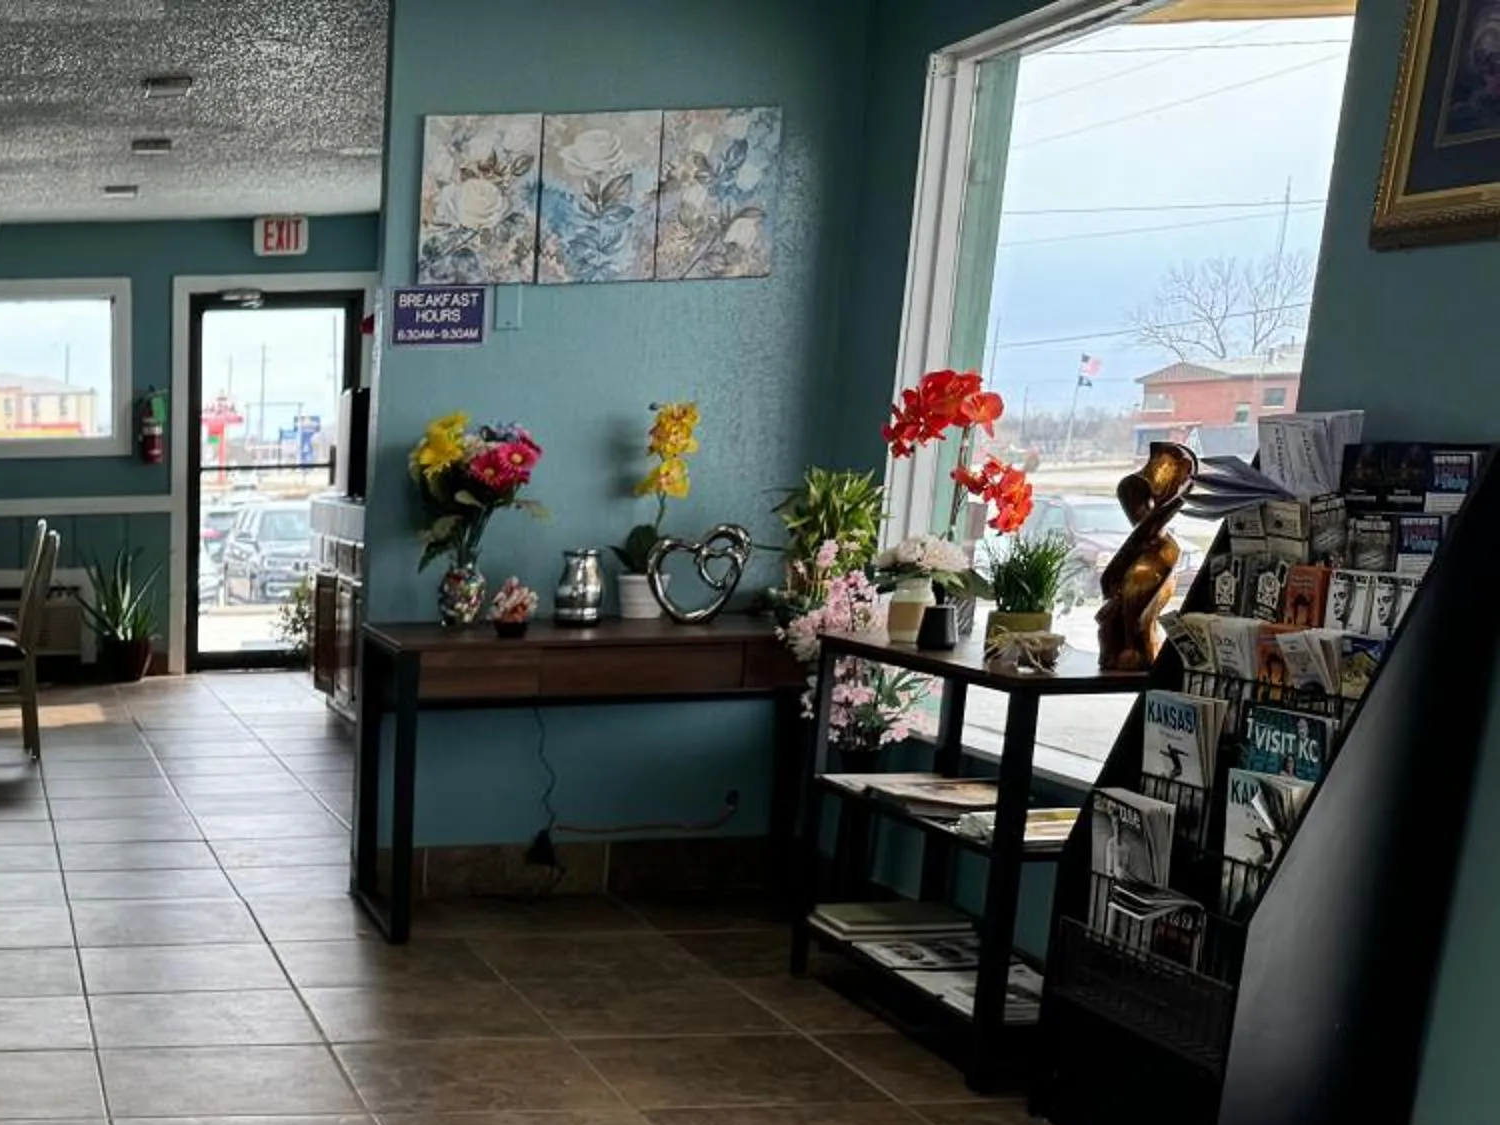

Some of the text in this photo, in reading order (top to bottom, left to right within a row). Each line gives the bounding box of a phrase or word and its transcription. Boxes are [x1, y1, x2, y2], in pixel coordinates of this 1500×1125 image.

[263, 217, 302, 251] EXIT
[399, 292, 480, 308] BREAKFAST
[415, 308, 461, 323] HOURS
[1255, 724, 1297, 754] VISIT
[1298, 738, 1319, 763] KC
